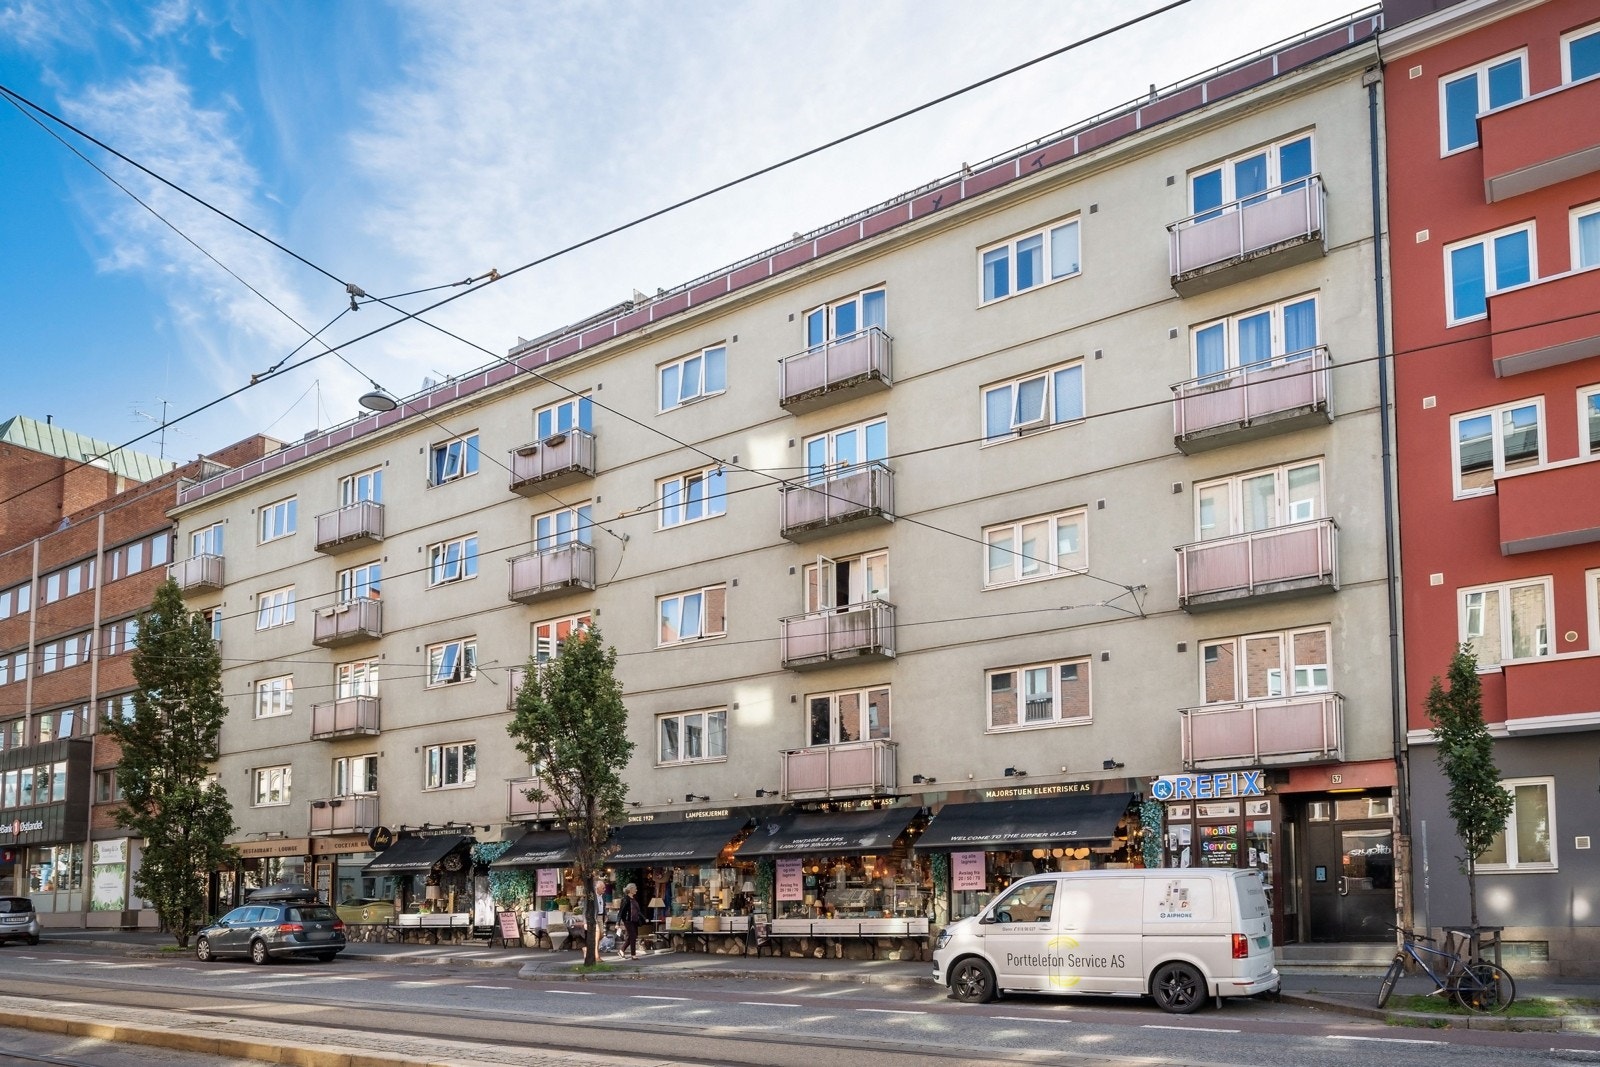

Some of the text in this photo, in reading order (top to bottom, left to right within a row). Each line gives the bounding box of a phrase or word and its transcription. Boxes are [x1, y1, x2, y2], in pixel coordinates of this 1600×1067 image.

[1333, 775, 1341, 783] 57
[1175, 771, 1261, 799] REFIX
[986, 788, 1032, 798] MAJORSTUEN
[1034, 785, 1078, 795] ELEKTRISKE
[685, 810, 729, 818] LAMPESKJERMER
[1205, 825, 1237, 836] Mobile
[1203, 841, 1238, 851] Service
[1007, 953, 1125, 968] Porttelefon Service AS
